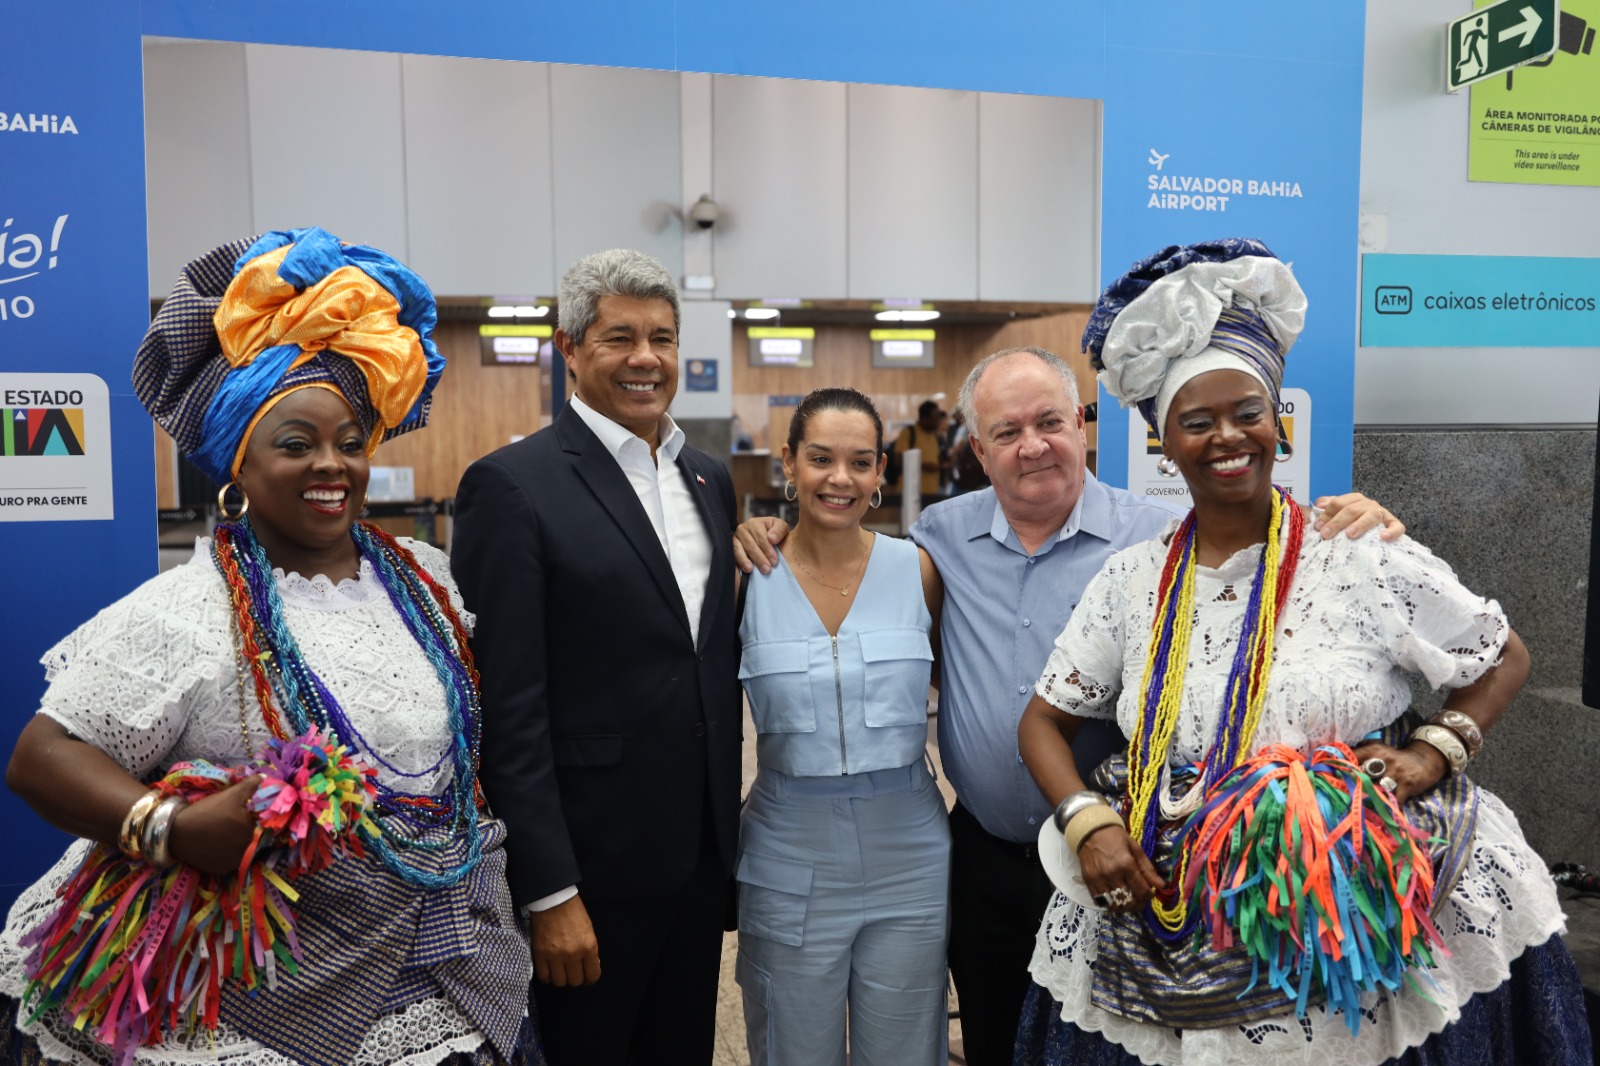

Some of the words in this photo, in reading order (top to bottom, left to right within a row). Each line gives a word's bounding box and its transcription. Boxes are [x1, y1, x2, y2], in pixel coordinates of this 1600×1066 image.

[1485, 107, 1514, 119] ÁREA
[1516, 111, 1588, 123] MONITORADA
[1481, 120, 1535, 133] CÂMERAS
[1537, 124, 1552, 134] DE
[1515, 149, 1531, 159] This
[1531, 152, 1549, 160] area
[1550, 151, 1557, 160] is
[1558, 152, 1580, 161] under
[1514, 160, 1535, 169] video
[1535, 161, 1580, 171] surveillance
[1147, 174, 1244, 194] SALVADOR
[1381, 294, 1408, 307] ATM
[1424, 291, 1487, 310] caixas
[1491, 291, 1596, 312] eletrônicos
[4, 389, 84, 406] ESTADO
[1145, 487, 1185, 496] GOVERNO
[26, 496, 49, 506] PRA
[51, 495, 88, 506] GENTE
